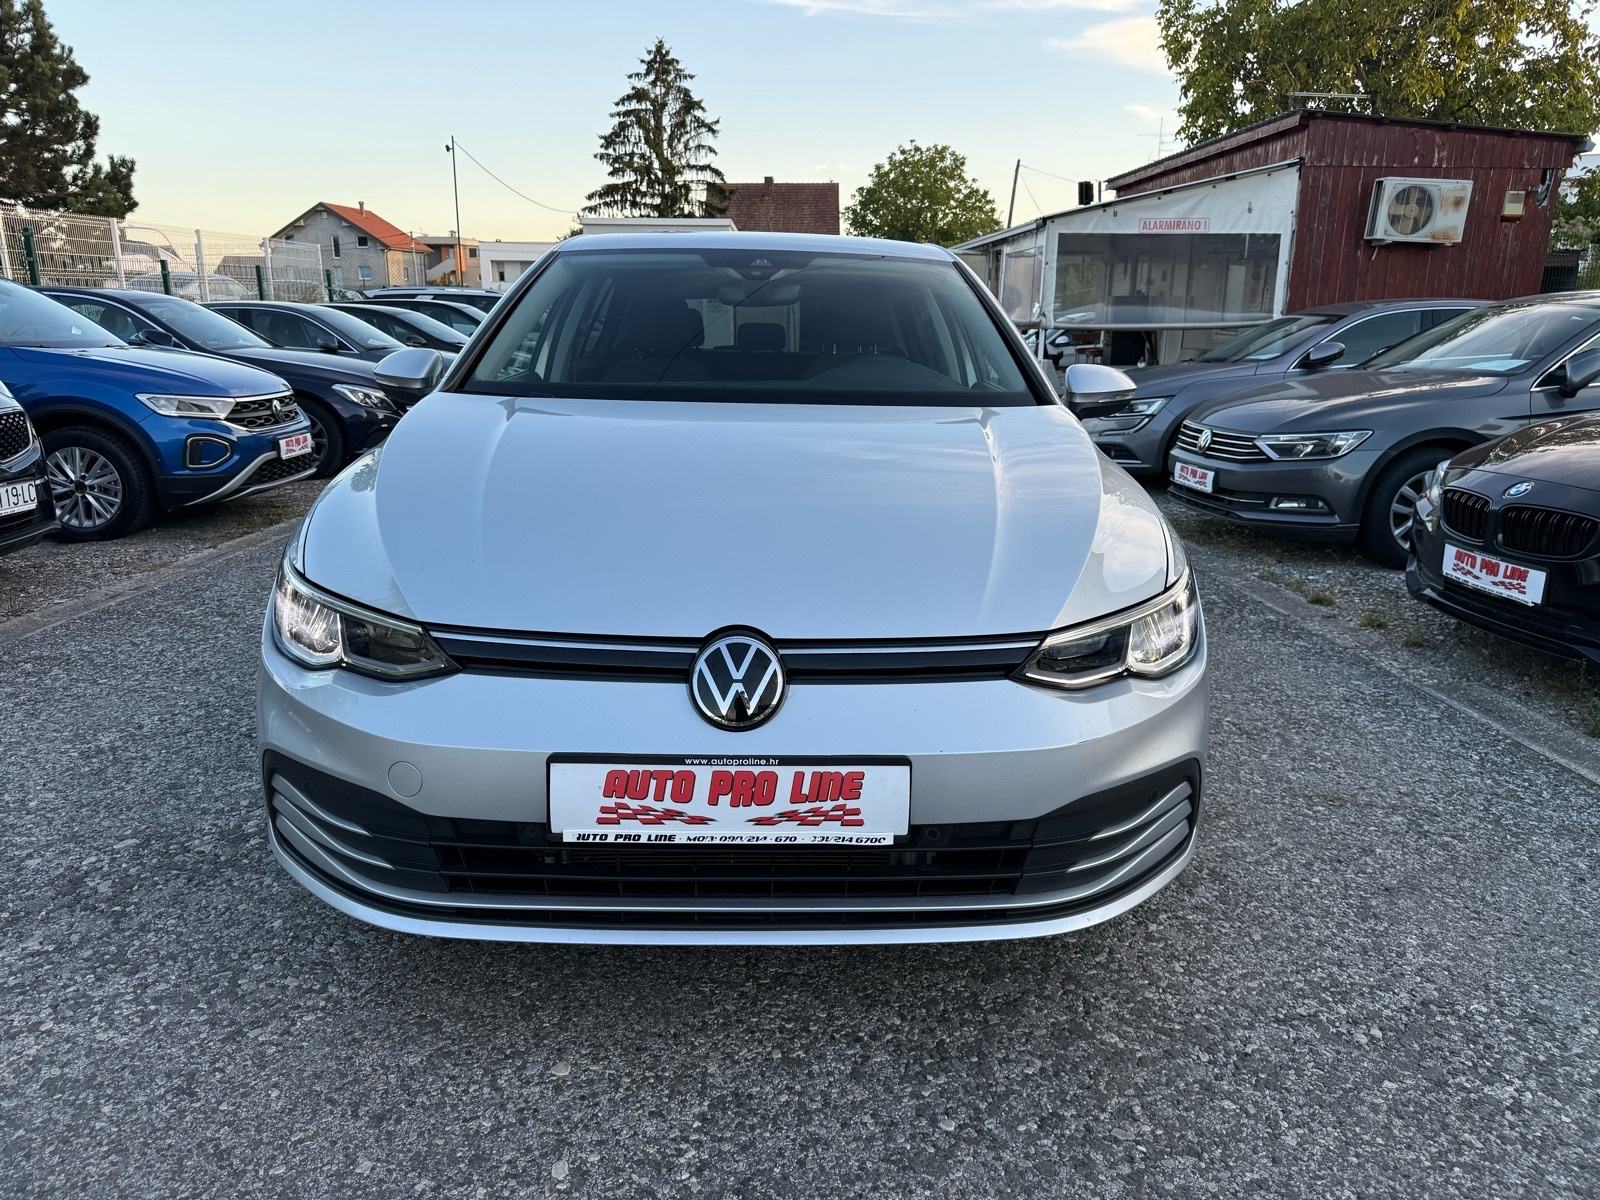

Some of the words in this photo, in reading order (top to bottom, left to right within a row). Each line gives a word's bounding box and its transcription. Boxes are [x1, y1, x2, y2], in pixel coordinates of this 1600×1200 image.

[1142, 220, 1201, 231] ALARMIRANO
[1454, 549, 1477, 569] AUTO
[1479, 557, 1501, 577] PRO
[1503, 565, 1530, 582] LINE
[684, 756, 780, 766] www.autoproline.hr
[602, 769, 696, 804] AUTO
[707, 770, 779, 807] PRO
[789, 770, 865, 804] LINE
[613, 833, 642, 842] PRO
[646, 834, 677, 842] LINE
[774, 835, 798, 843] 670
